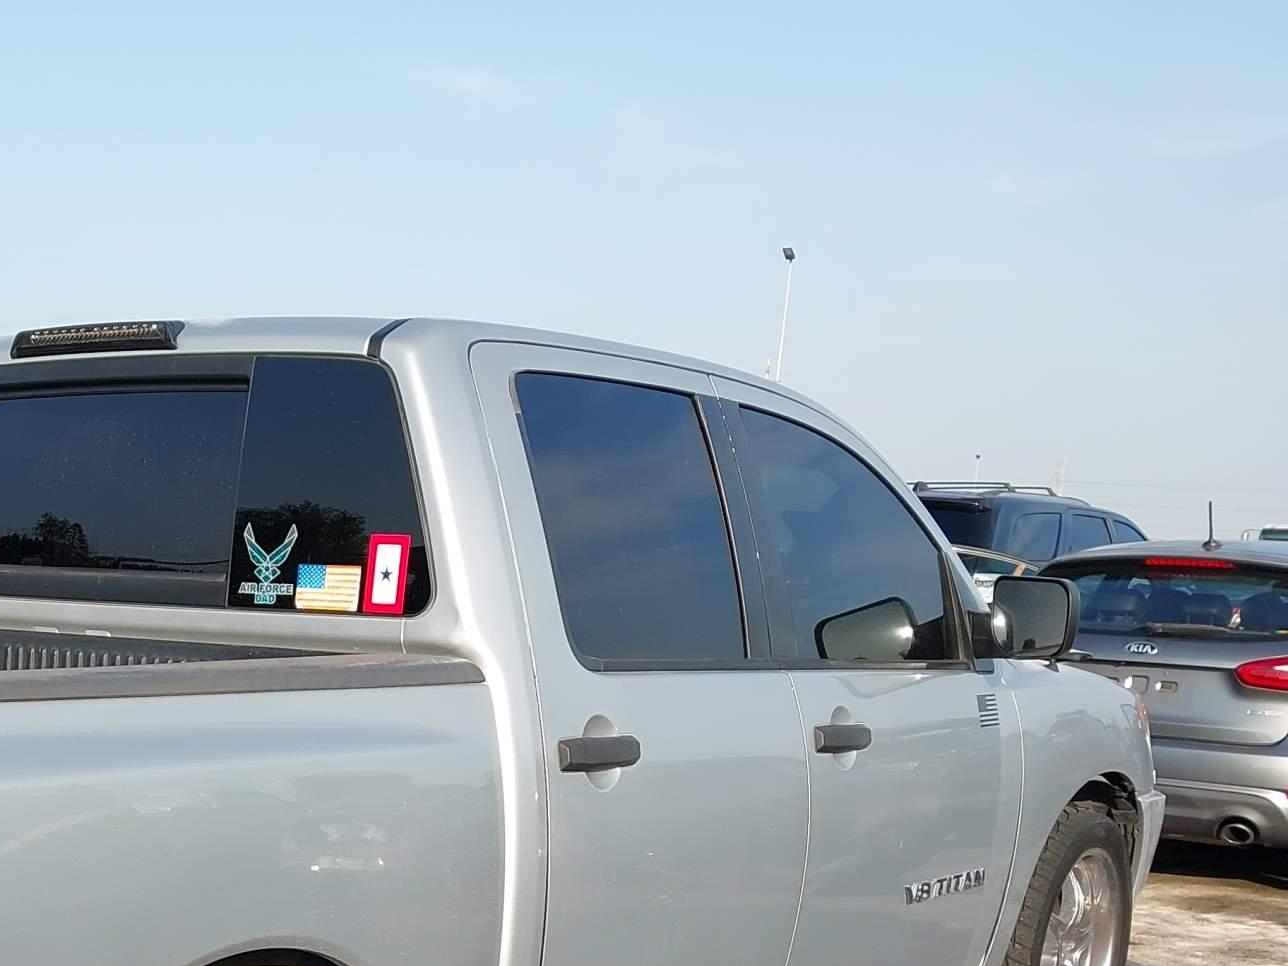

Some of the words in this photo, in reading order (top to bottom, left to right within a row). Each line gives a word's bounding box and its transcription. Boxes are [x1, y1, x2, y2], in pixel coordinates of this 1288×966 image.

[238, 582, 258, 594] AIR
[259, 583, 294, 595] FORCE
[254, 594, 277, 604] DAD
[1129, 643, 1158, 655] KIA
[932, 867, 986, 899] TITAN
